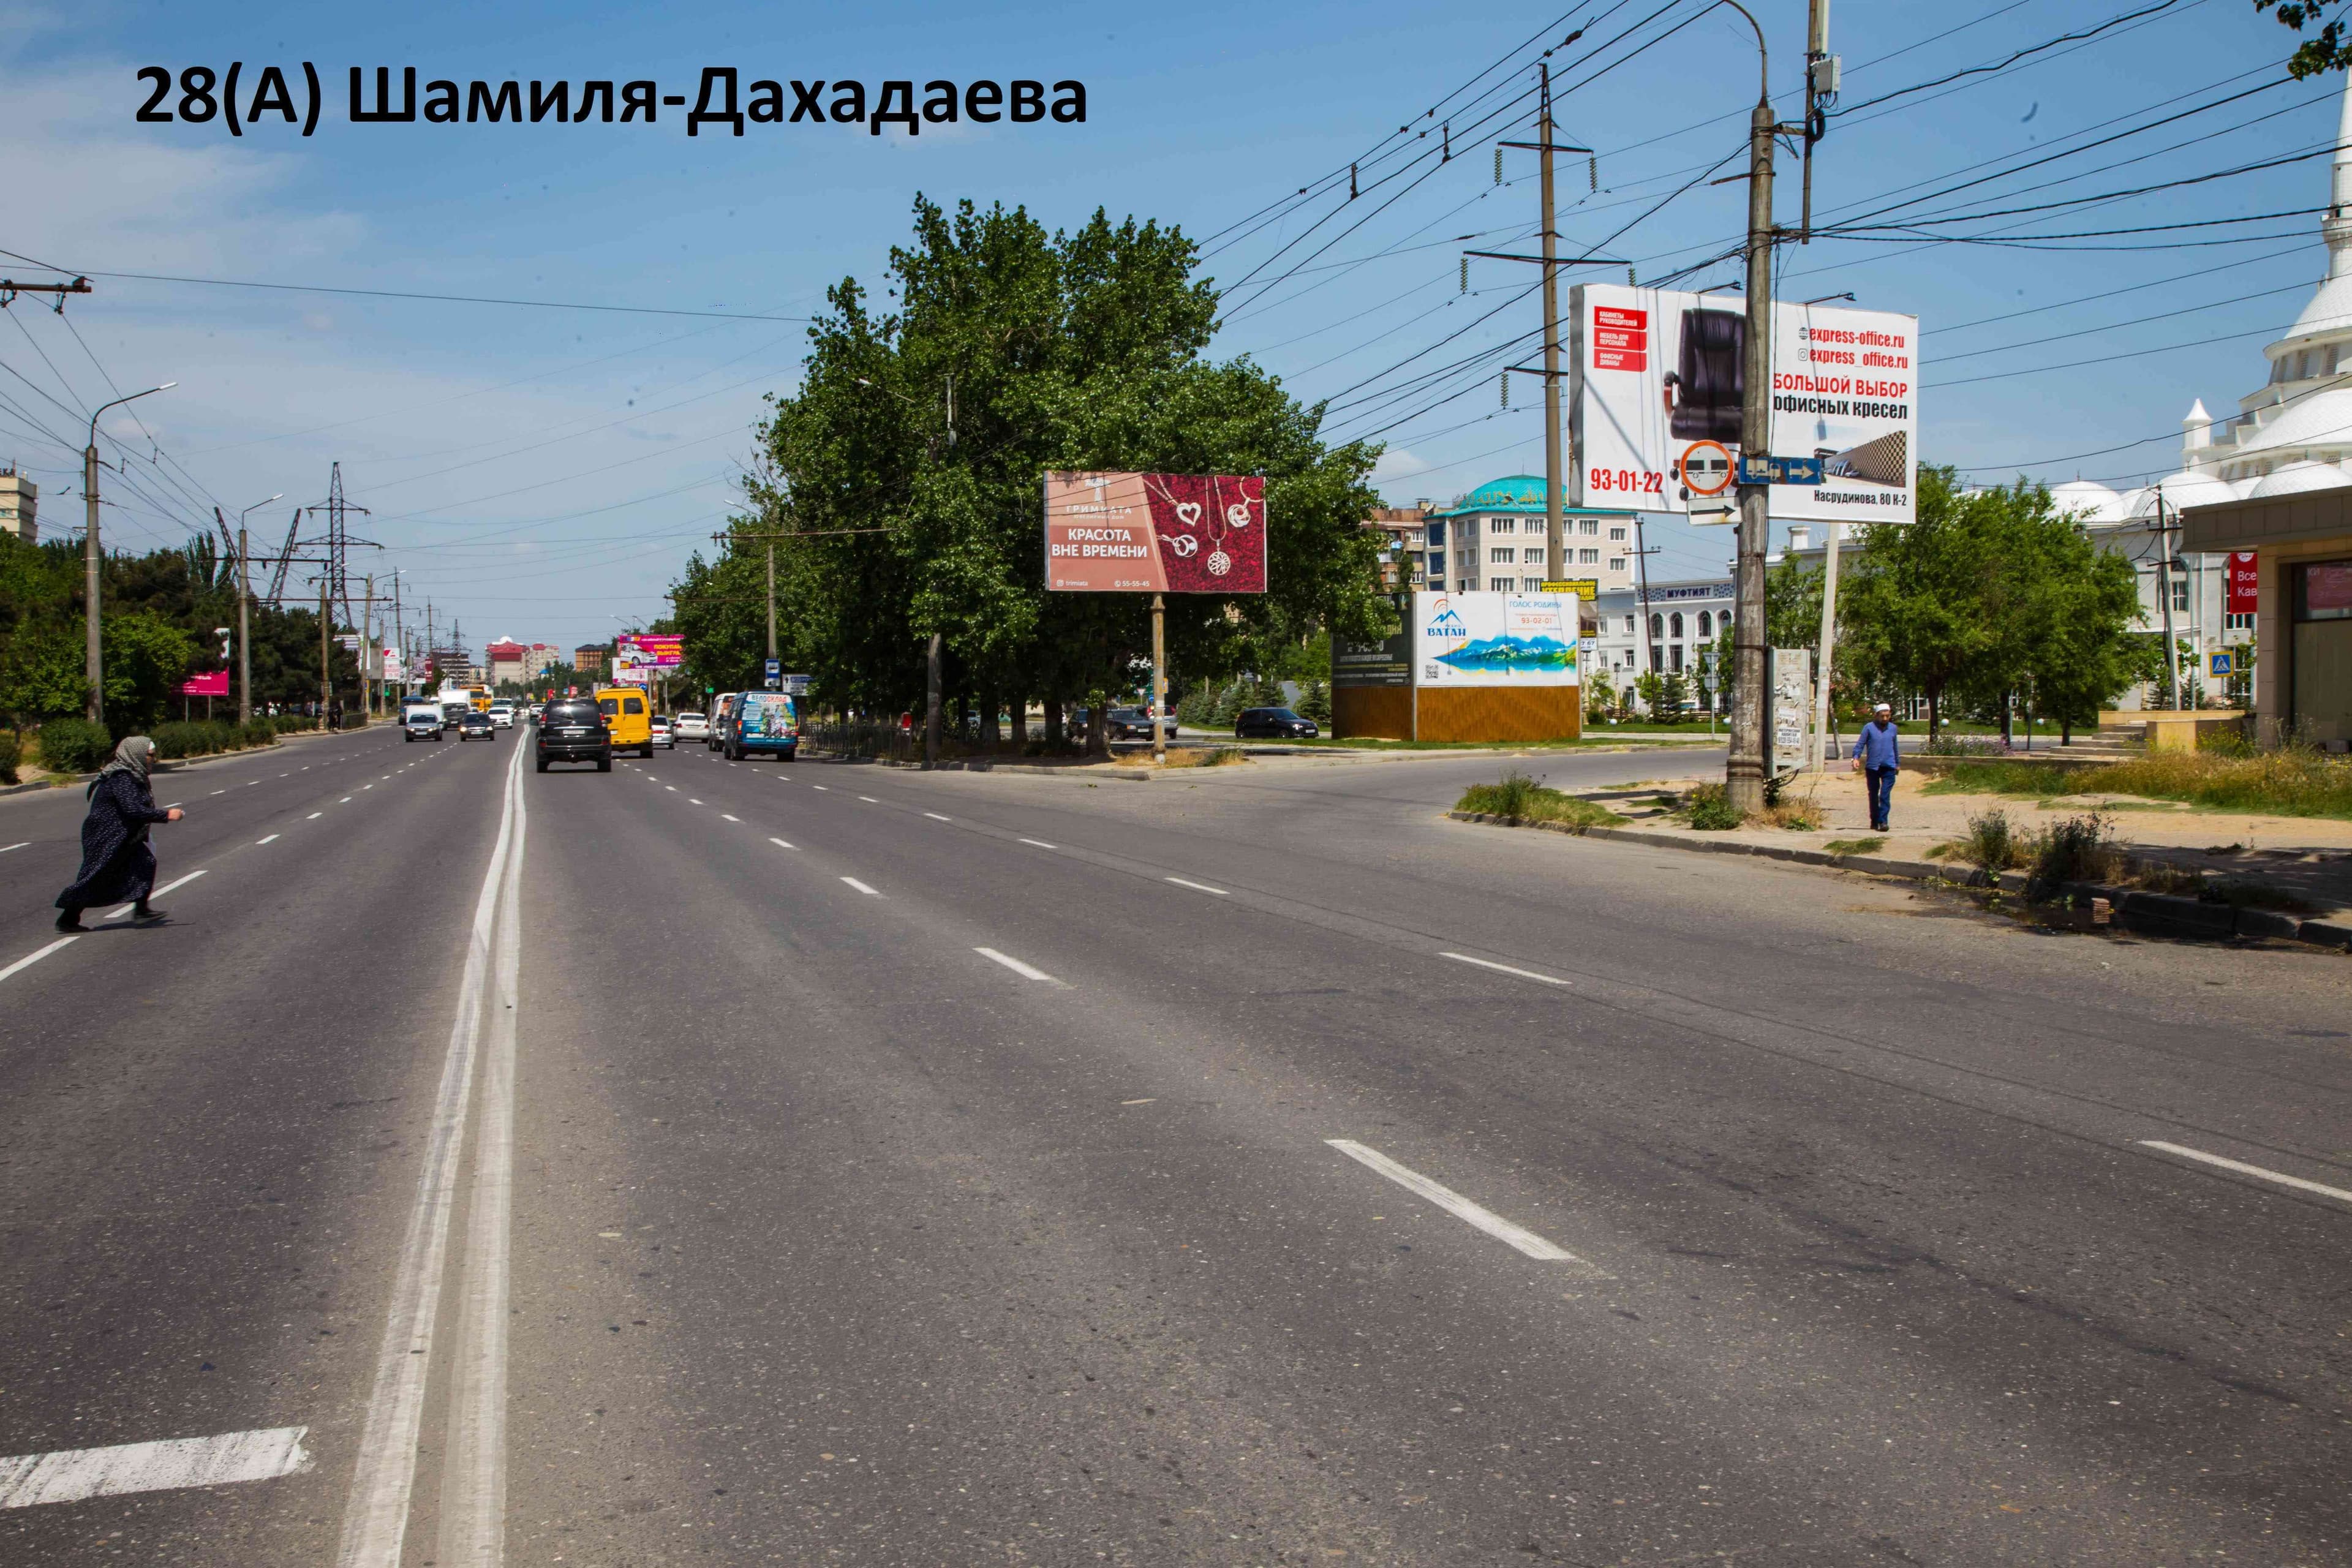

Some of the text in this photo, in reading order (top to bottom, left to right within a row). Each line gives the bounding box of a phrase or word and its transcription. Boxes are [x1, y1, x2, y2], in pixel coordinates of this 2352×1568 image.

[1810, 328, 1904, 348] express-office.ru
[1810, 349, 1908, 369] express_office.ru
[1774, 373, 1907, 398] БОЛЬШОЙ ВЫБОР
[1774, 395, 1907, 419] офисных кресел
[1591, 468, 1663, 493] 93-01-22
[1814, 490, 1878, 505] Насрудинова,
[1880, 493, 1891, 505] 80
[1068, 529, 1131, 541] КРАСОТА
[1052, 544, 1147, 557] ВНЕ ВРЕМЕНИ
[2237, 571, 2257, 581] Все
[1667, 588, 1711, 598] МУФТИЯТ
[1427, 628, 1466, 636] ВАТАН
